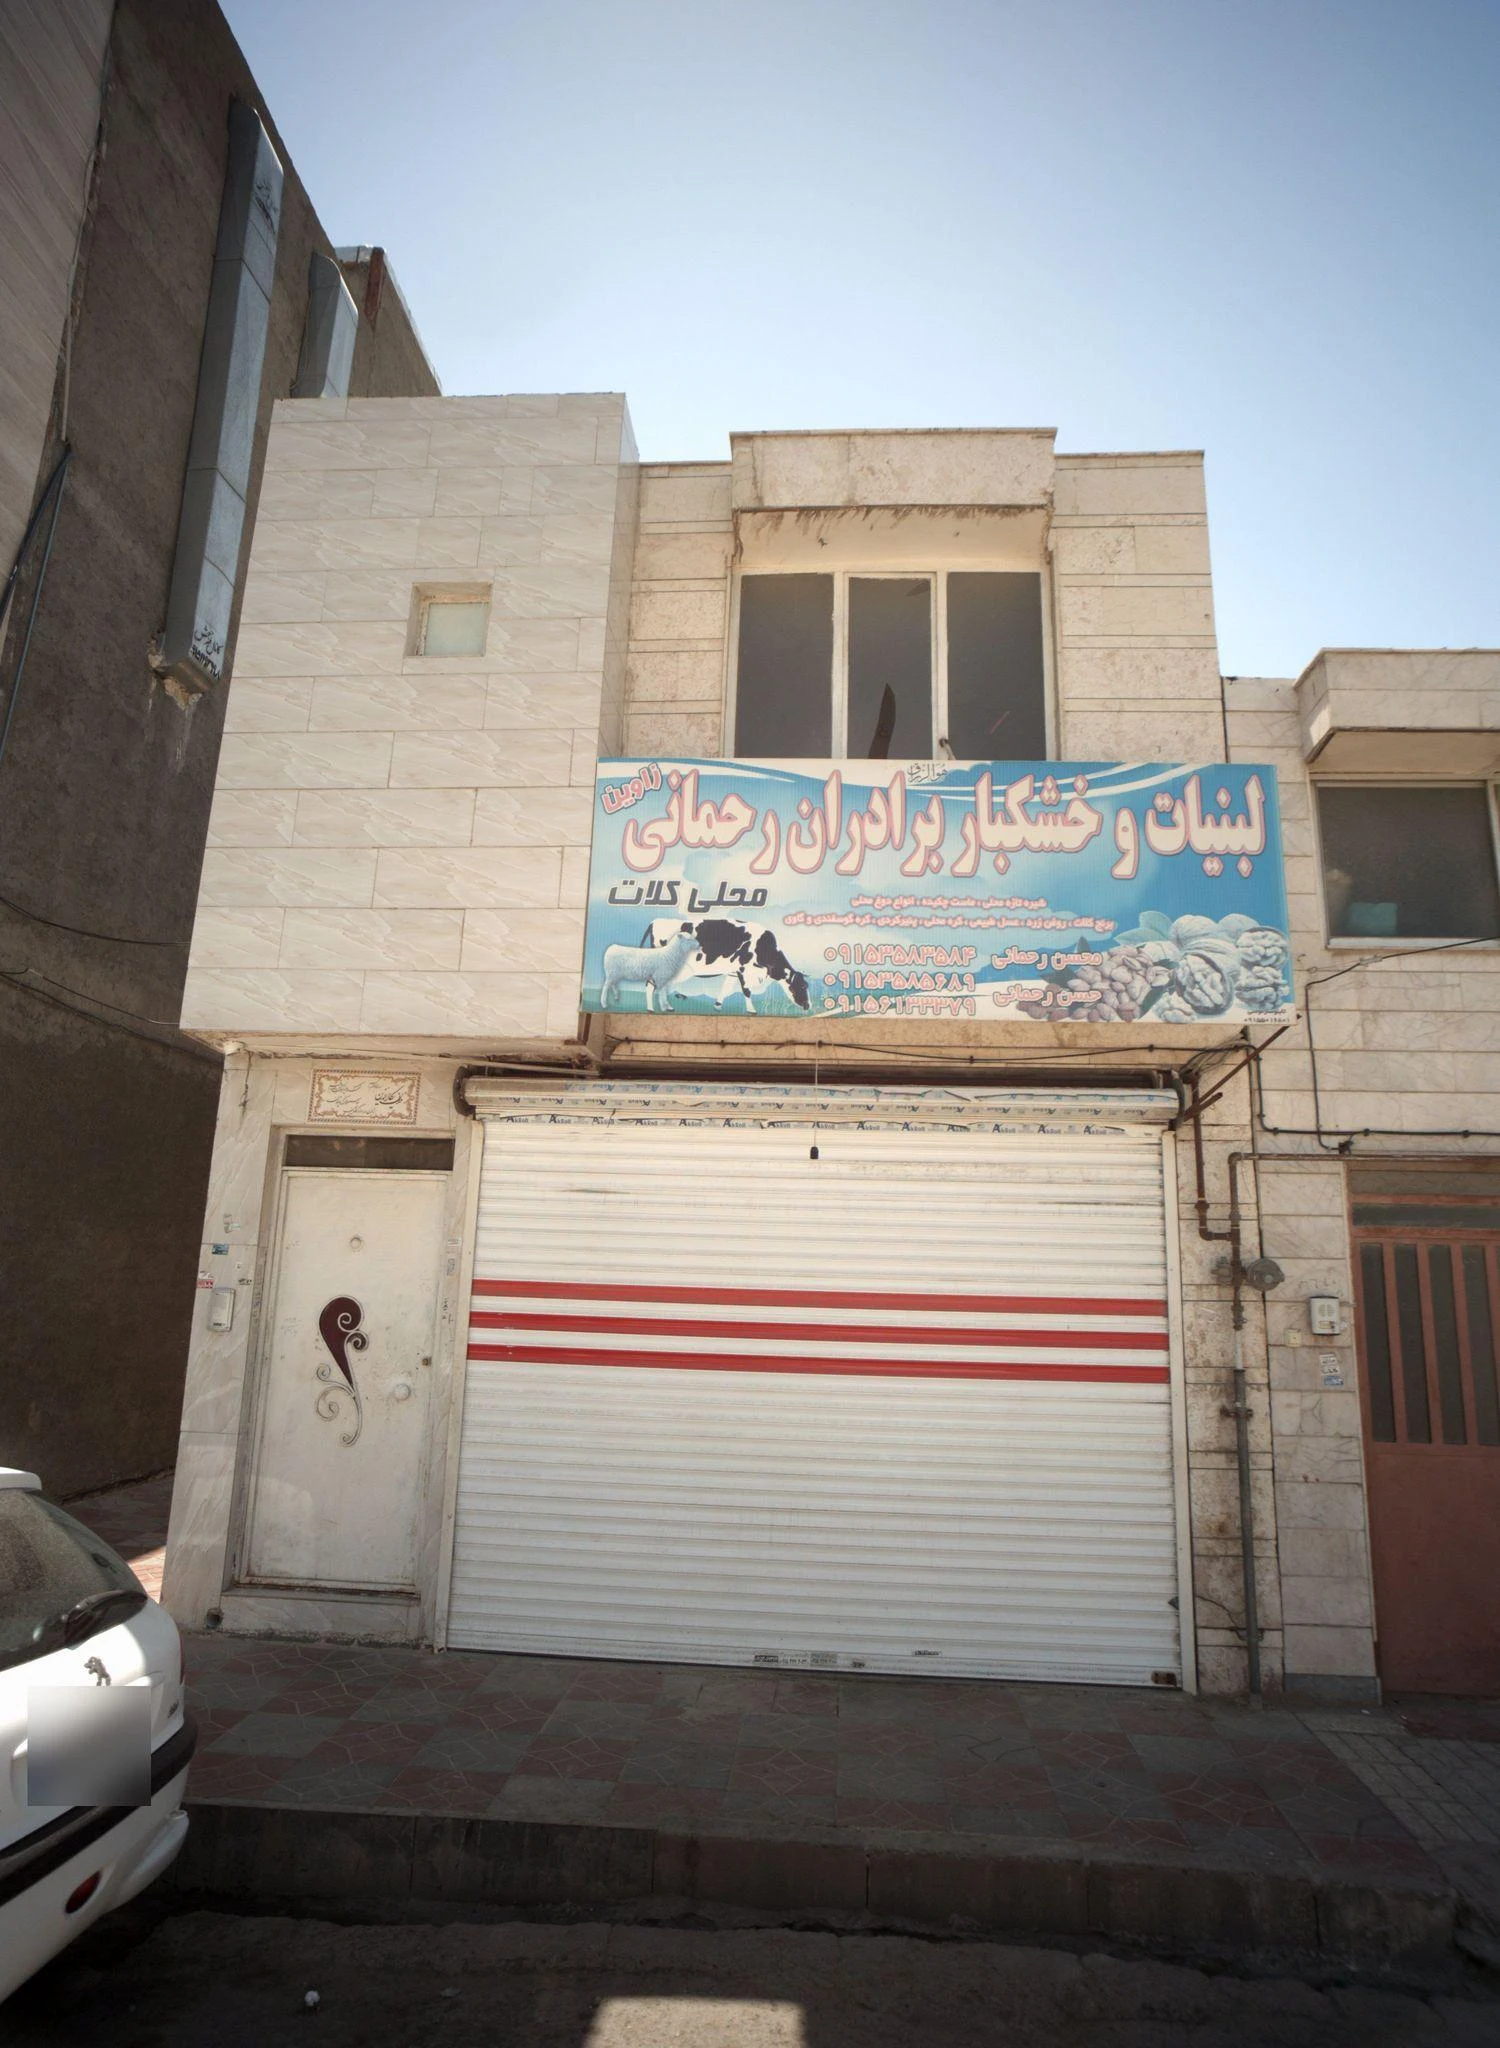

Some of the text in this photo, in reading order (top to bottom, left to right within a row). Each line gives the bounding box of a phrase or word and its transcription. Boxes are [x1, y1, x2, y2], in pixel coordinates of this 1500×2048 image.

[601, 762, 662, 814] زاوین
[622, 767, 1266, 880] لبنیات و خشکبار برادران رحمانی
[608, 880, 768, 913] محلی کلات
[783, 911, 806, 926] گاوی
[813, 911, 855, 927] گوسفندی
[824, 942, 978, 967] ۰۹۱۵۳۵۸۳۵۸۴
[991, 944, 1103, 971] محسن رحمانی
[823, 969, 977, 992] ۰۹۱۵۳۵۸۵۶۸۹
[992, 983, 1103, 1007] حسن رحمانی
